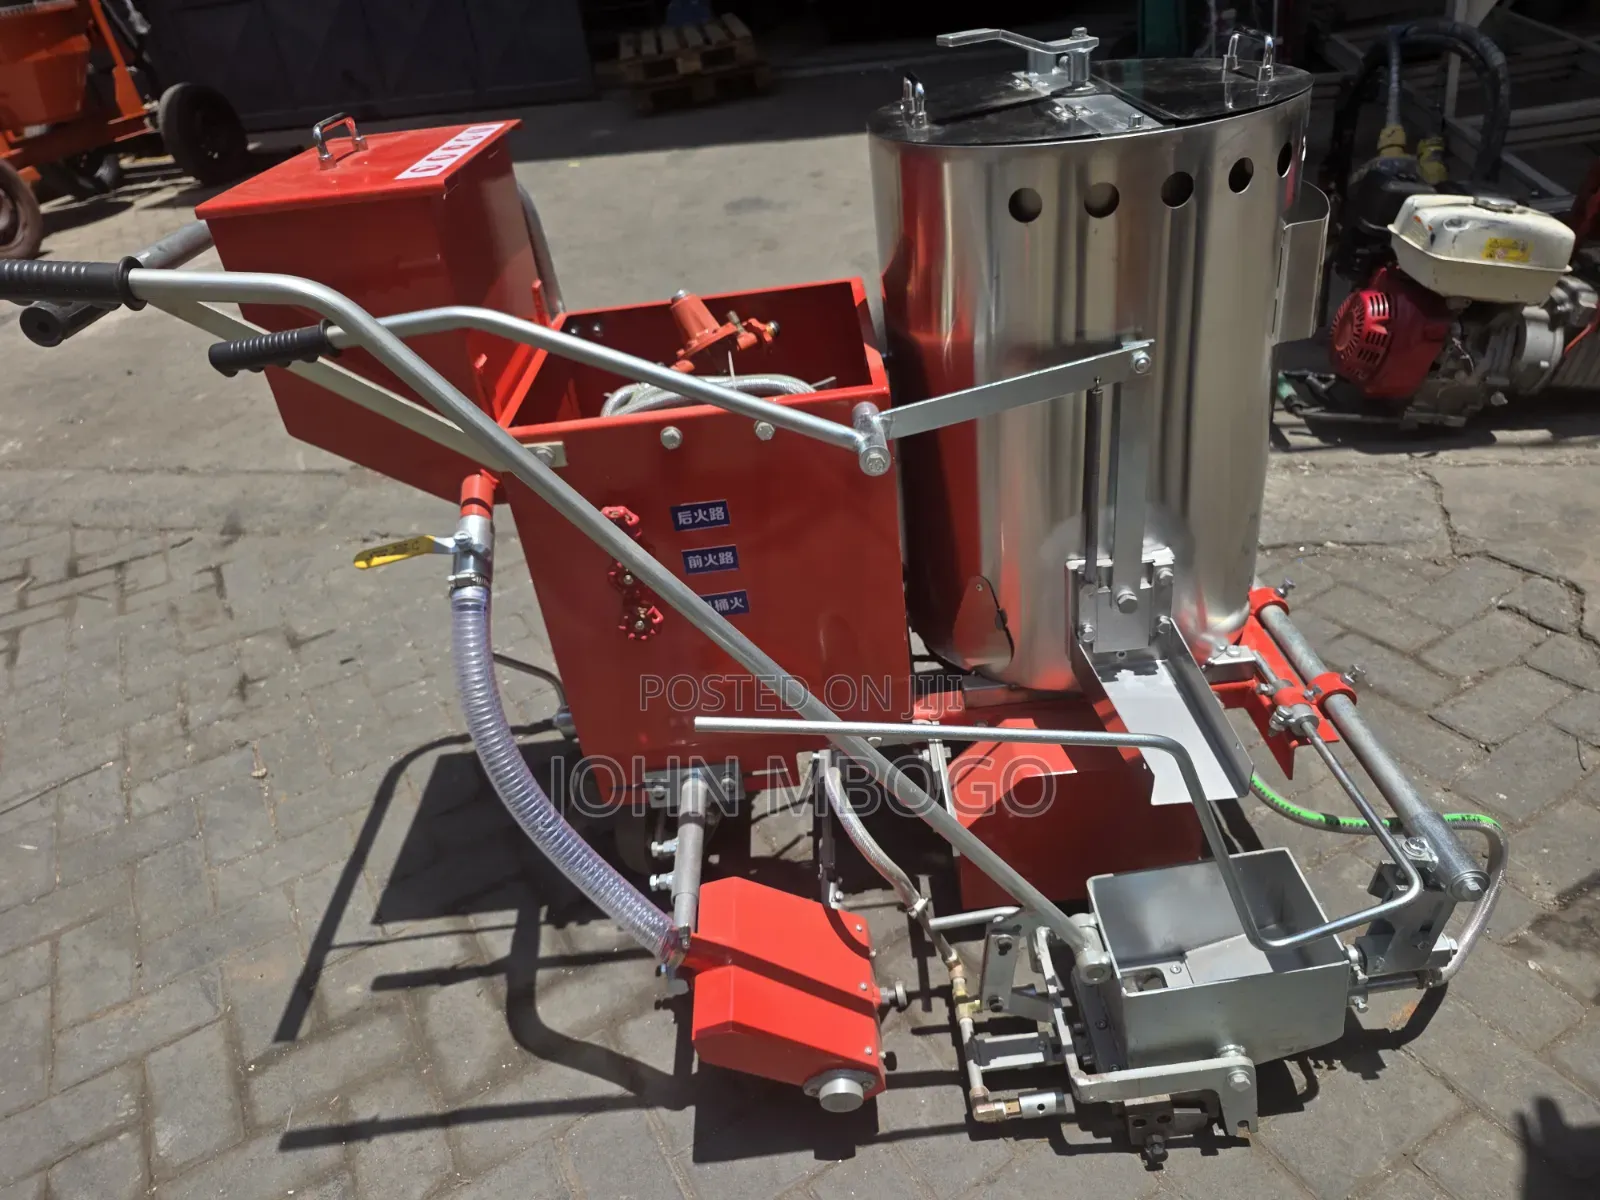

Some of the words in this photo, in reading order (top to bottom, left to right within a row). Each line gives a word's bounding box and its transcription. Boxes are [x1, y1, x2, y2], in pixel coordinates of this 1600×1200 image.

[677, 506, 725, 525] 后火路
[687, 551, 734, 569] 前火路
[708, 596, 745, 612] 桶火
